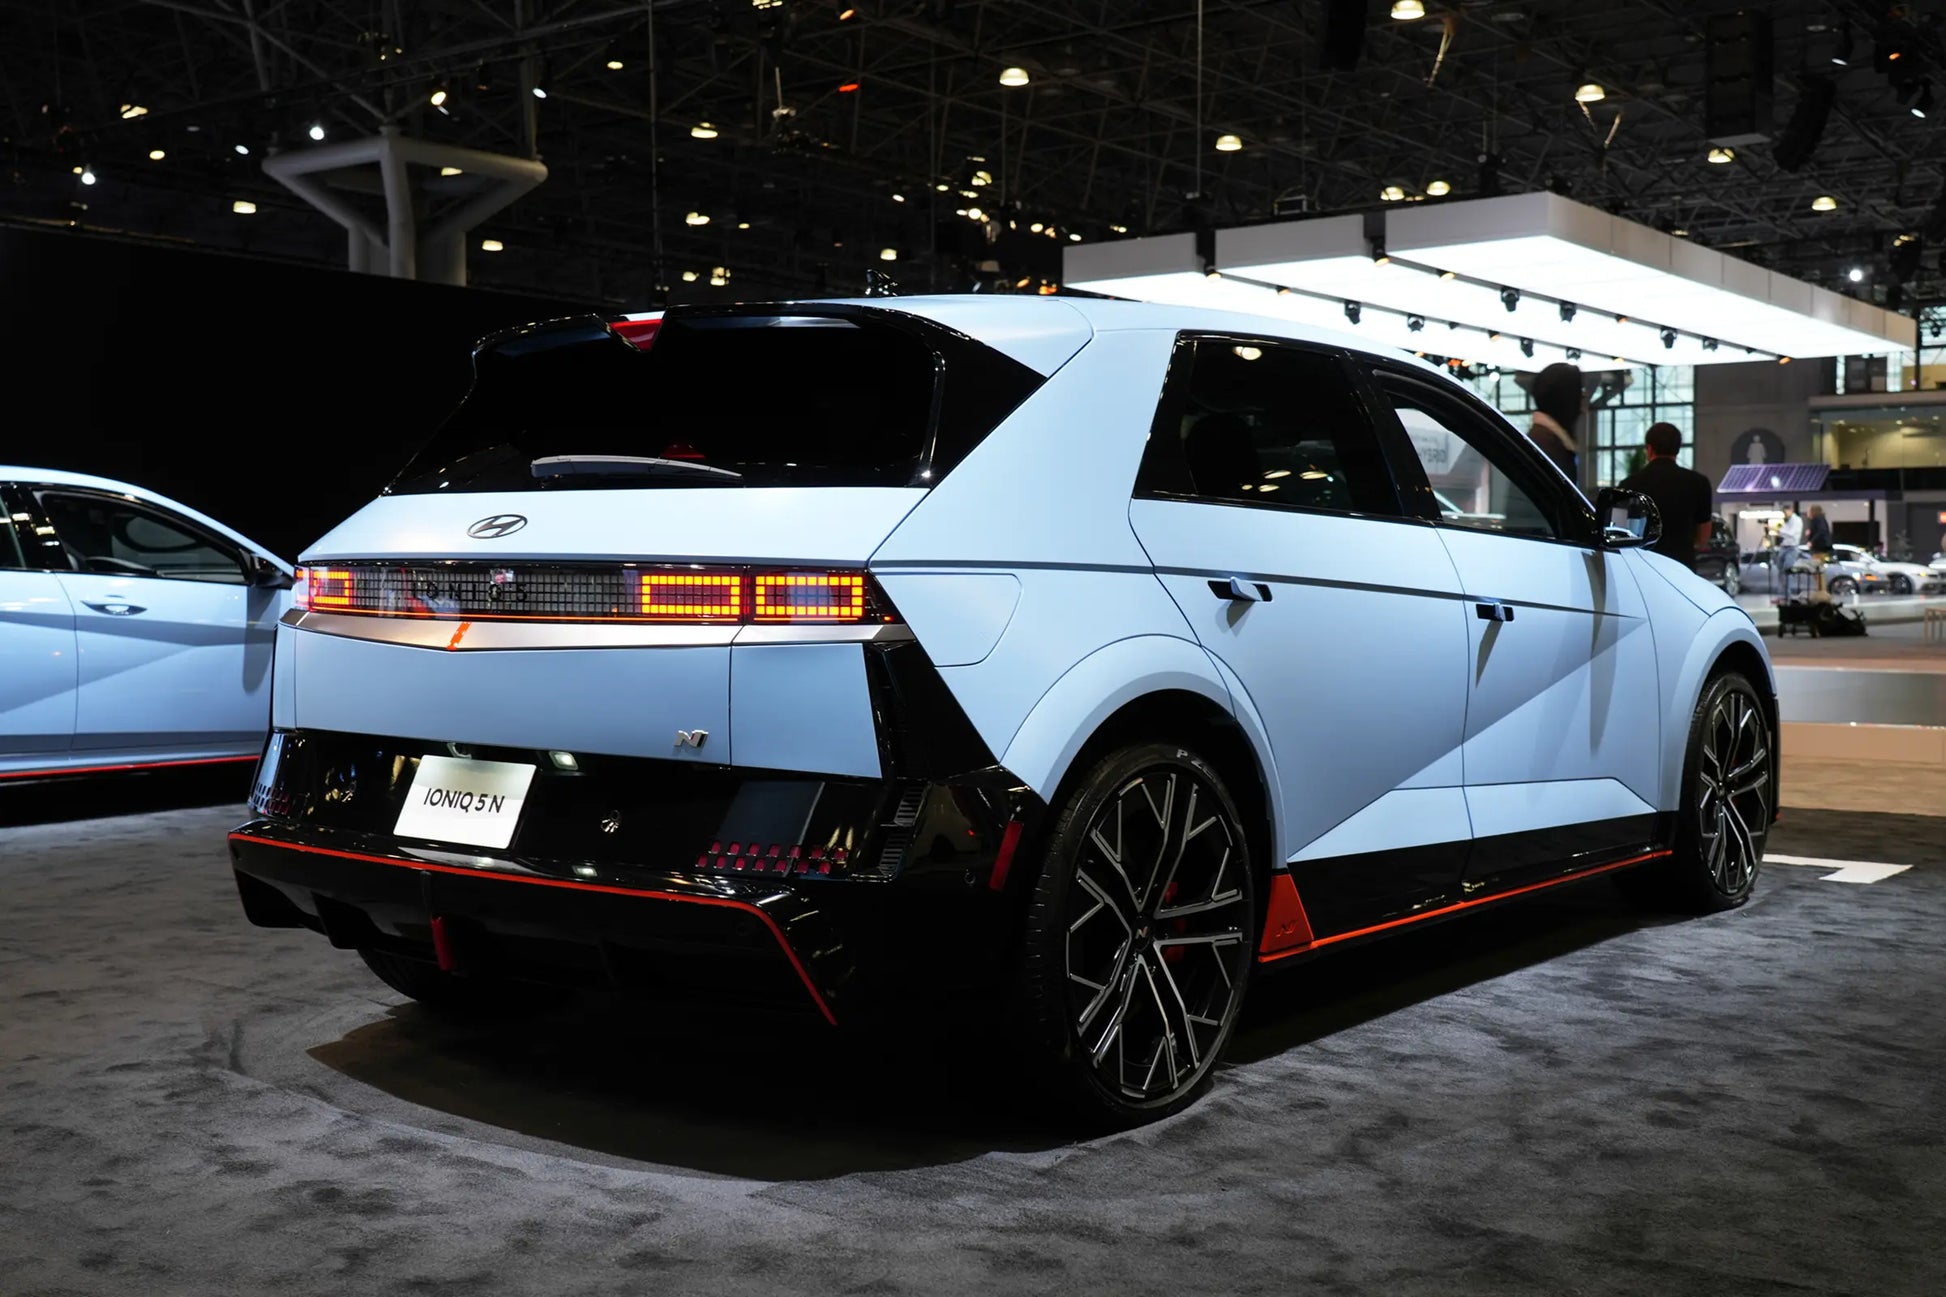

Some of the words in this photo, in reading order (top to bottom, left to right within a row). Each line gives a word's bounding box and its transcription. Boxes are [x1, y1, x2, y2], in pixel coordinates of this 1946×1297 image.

[674, 729, 709, 748] N
[424, 788, 474, 813] IONIQ
[474, 793, 489, 811] 5
[488, 796, 506, 813] N
